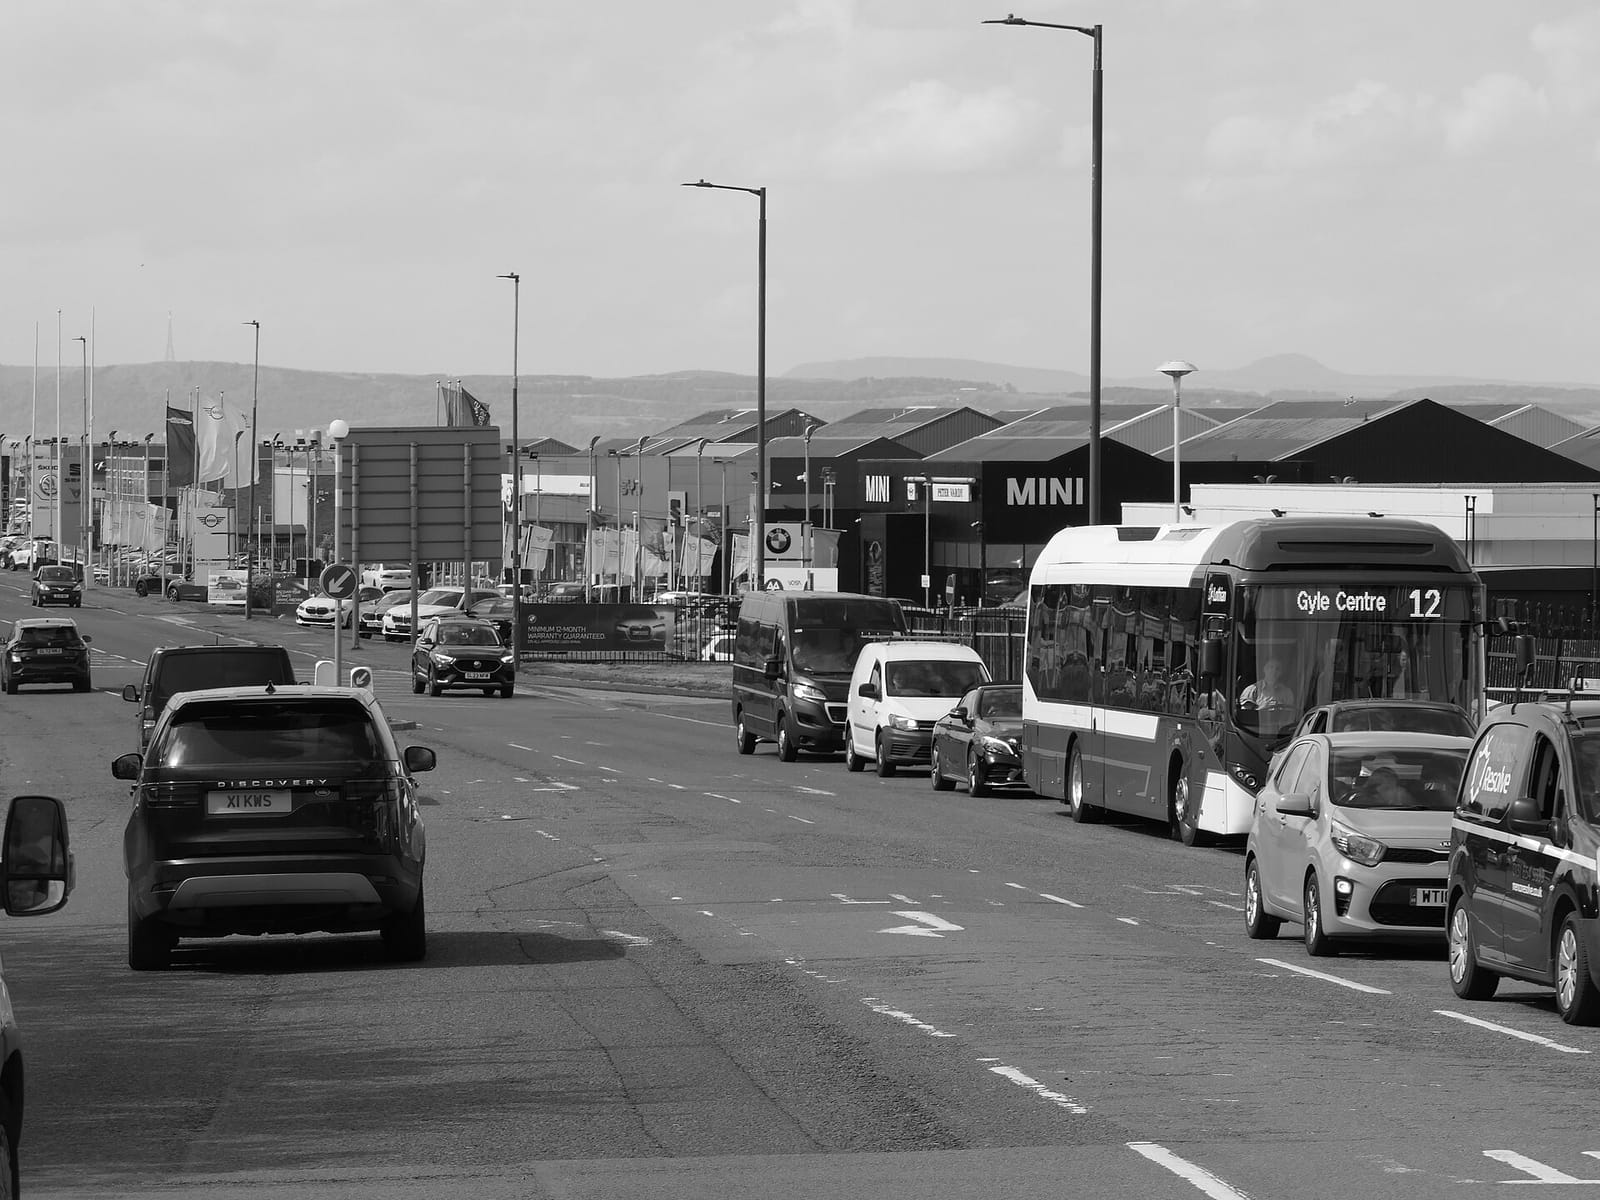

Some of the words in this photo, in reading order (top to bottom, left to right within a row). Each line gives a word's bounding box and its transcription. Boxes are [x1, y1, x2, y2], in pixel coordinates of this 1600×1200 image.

[866, 475, 889, 502] MINI
[1007, 478, 1083, 505] MINI
[1297, 591, 1330, 614] Gyle
[1336, 592, 1386, 611] Centre
[1409, 589, 1440, 618] 12
[218, 779, 327, 787] DISCOVERY
[1482, 766, 1511, 794] Resolve
[244, 795, 272, 808] KWS
